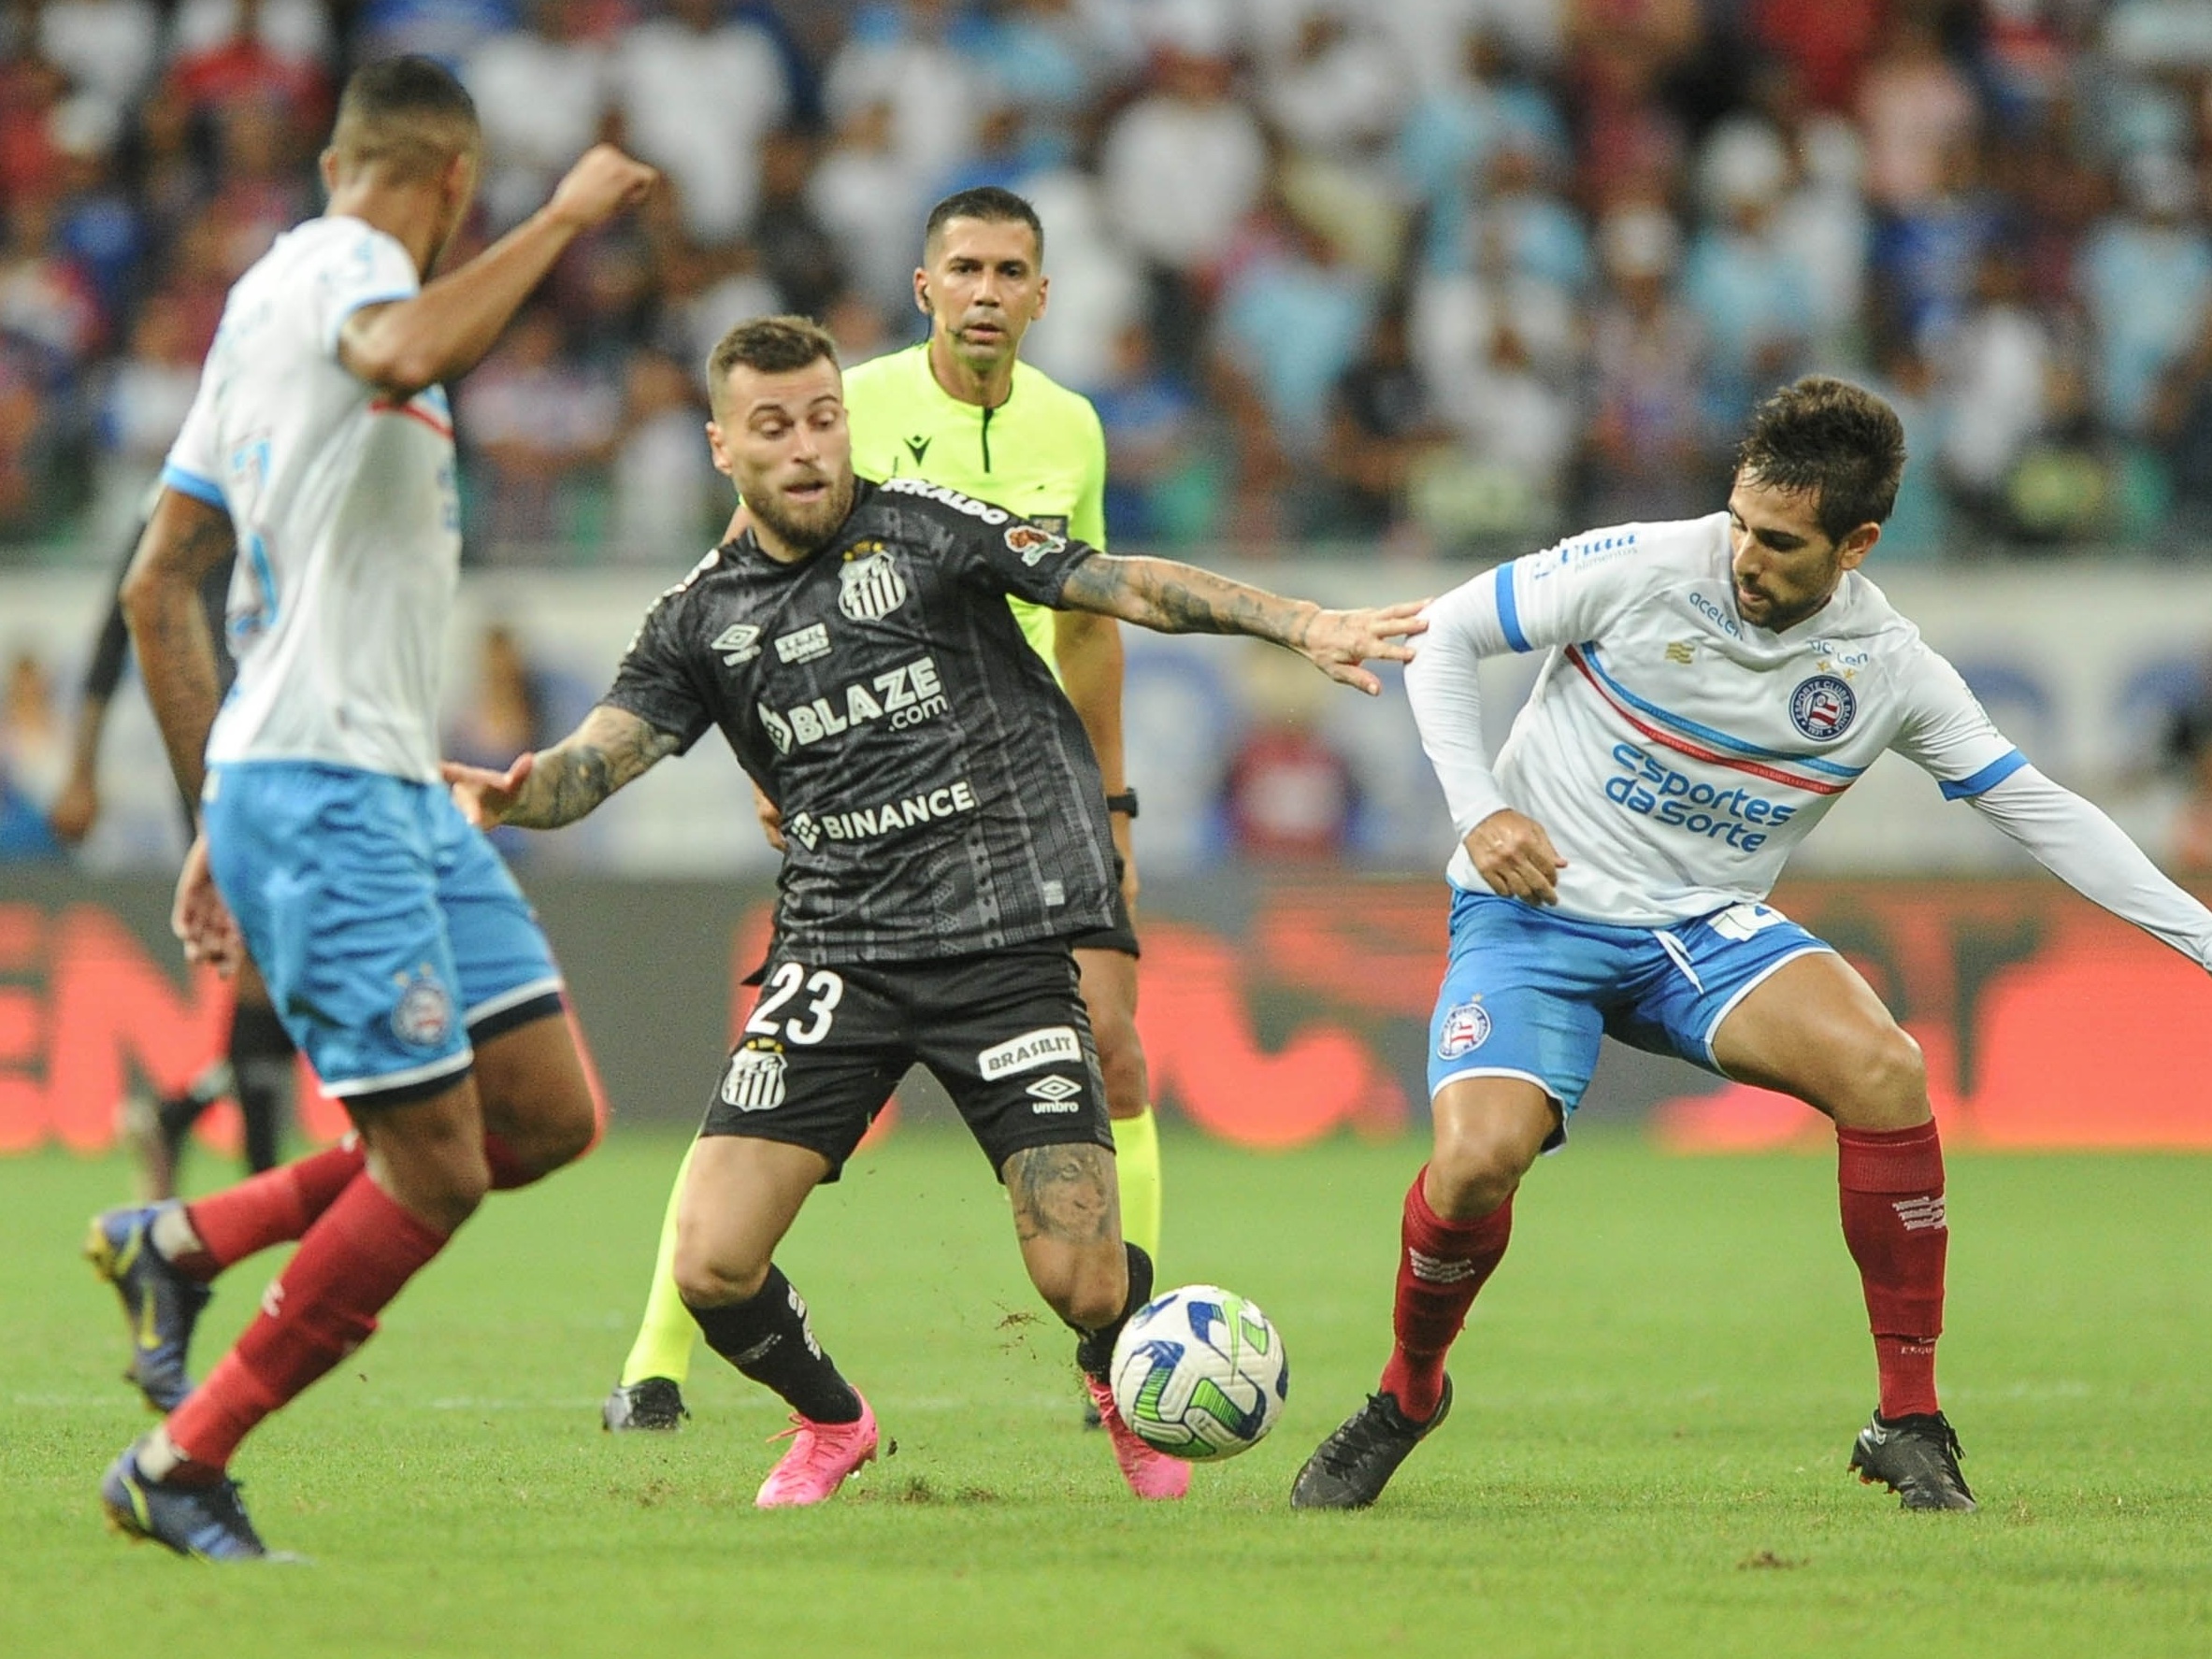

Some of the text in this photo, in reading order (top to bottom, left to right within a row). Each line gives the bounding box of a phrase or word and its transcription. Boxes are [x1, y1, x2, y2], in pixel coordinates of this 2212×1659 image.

[787, 657, 941, 747] BLAZE
[888, 694, 949, 733] .com
[823, 781, 975, 840] BINANCE
[745, 962, 843, 1045] 23
[987, 1036, 1073, 1072] BRASILIT
[1032, 1100, 1079, 1114] umbro
